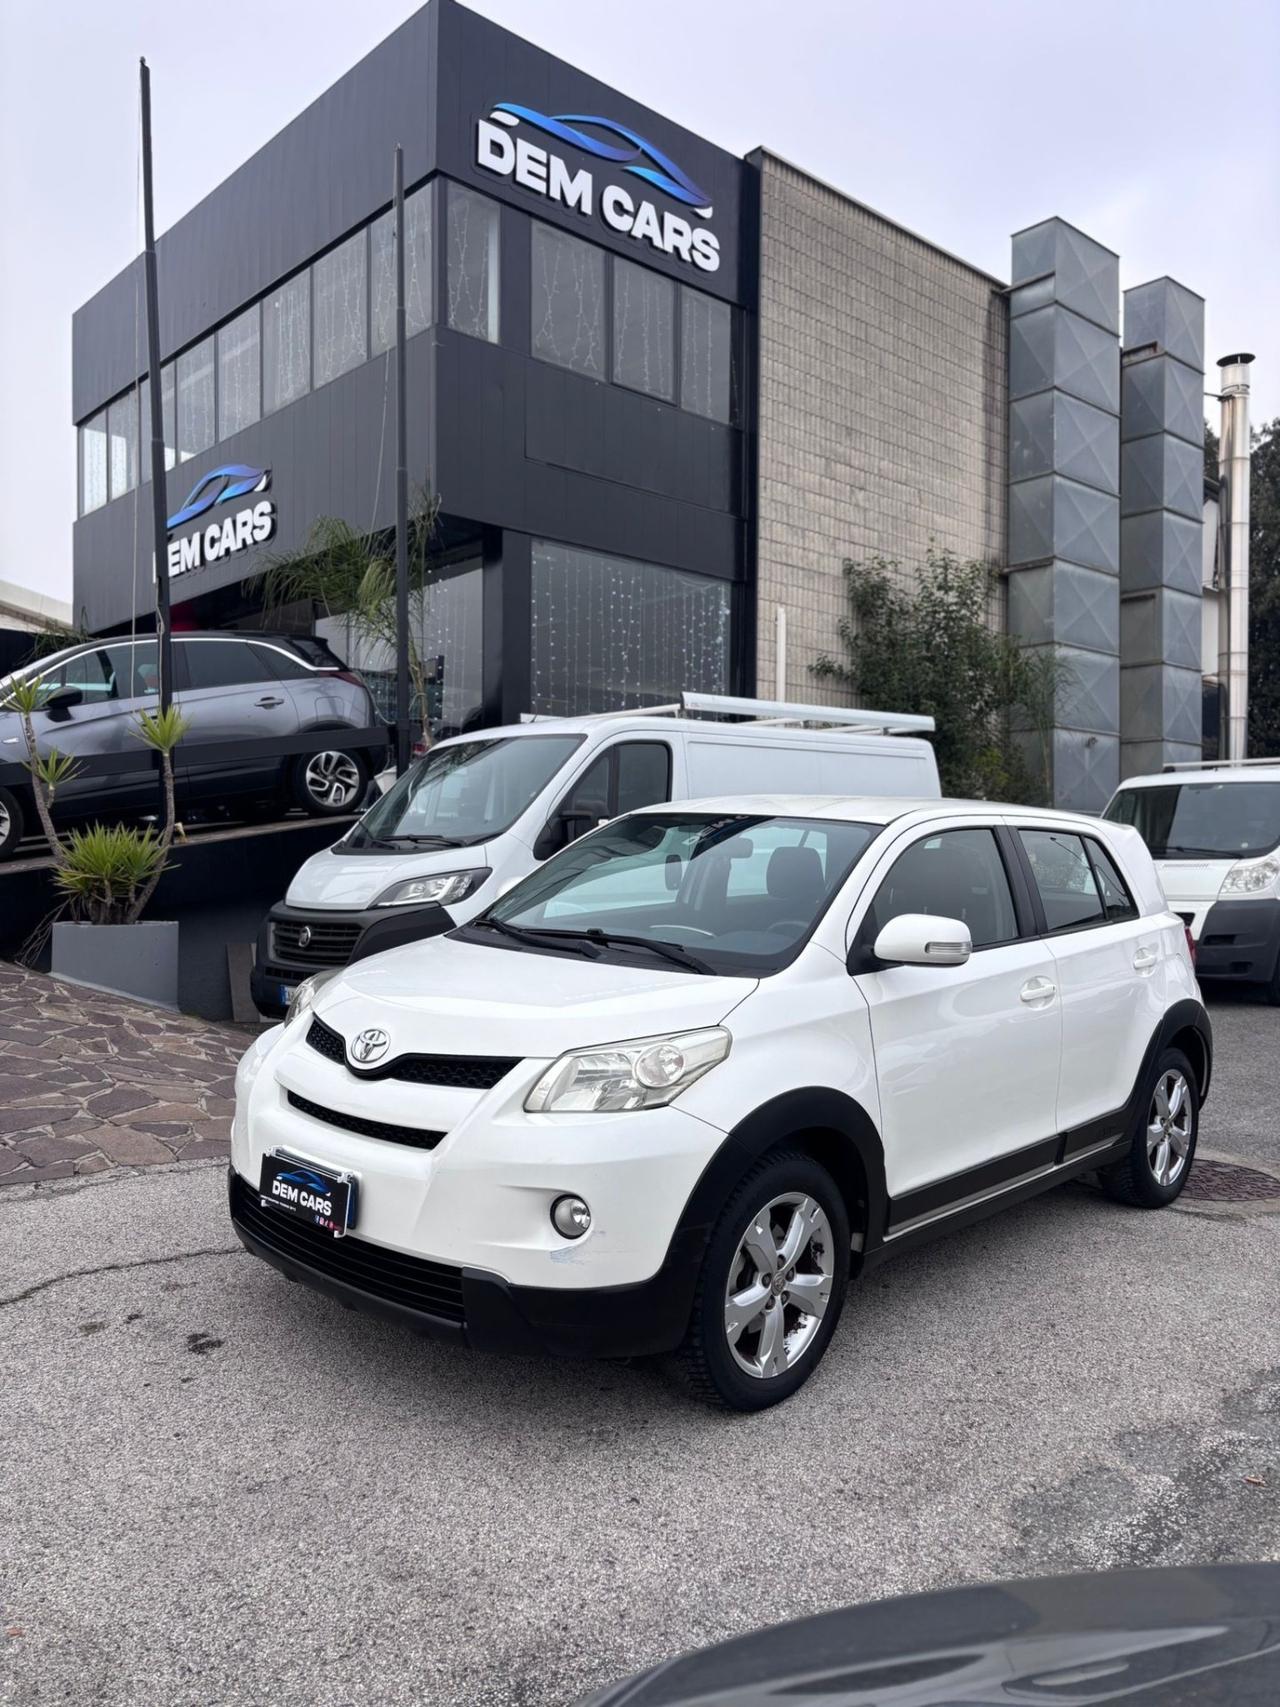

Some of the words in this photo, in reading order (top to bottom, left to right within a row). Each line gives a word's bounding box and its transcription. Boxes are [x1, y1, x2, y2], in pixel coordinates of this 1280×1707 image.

[478, 119, 593, 216] DEM
[602, 185, 720, 272] CARS
[152, 531, 200, 583] EM
[204, 501, 272, 561] CARS
[272, 1180, 298, 1203] DEM
[299, 1191, 332, 1216] CARS
